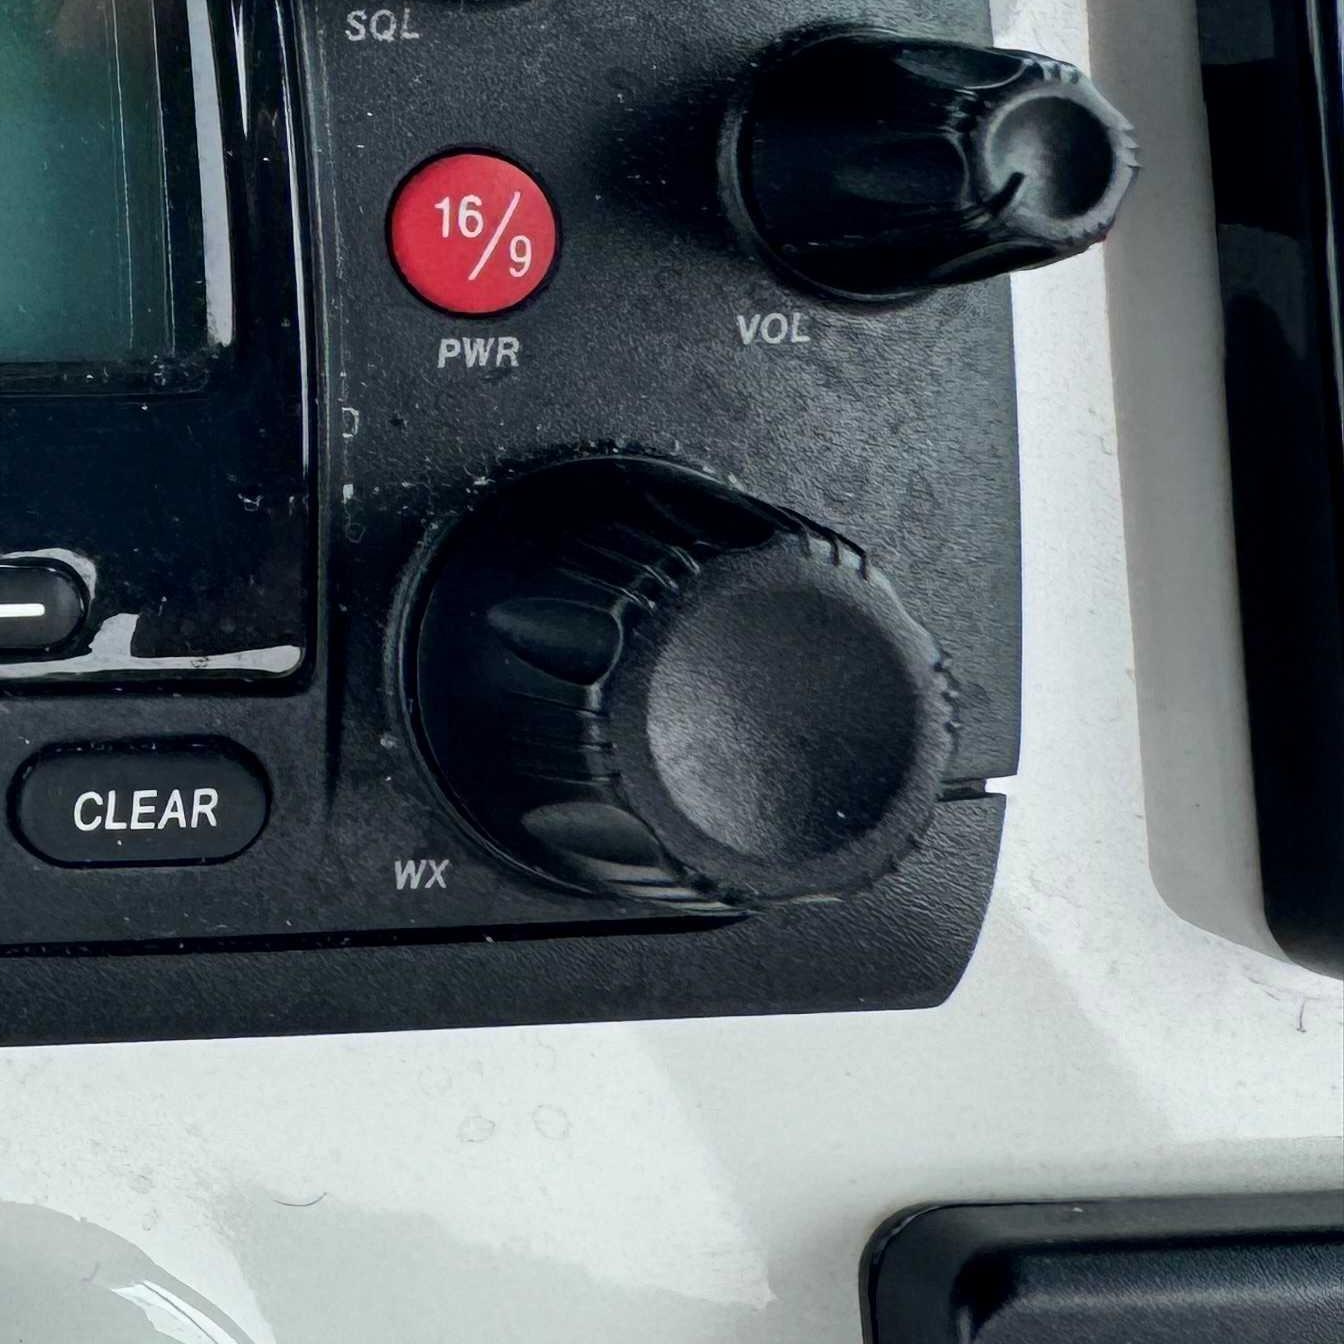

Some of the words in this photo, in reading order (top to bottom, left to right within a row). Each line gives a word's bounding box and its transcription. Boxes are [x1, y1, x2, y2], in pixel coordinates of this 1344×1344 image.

[345, 8, 420, 42] SQL
[736, 312, 811, 346] VOL
[437, 336, 520, 368] PWR
[73, 787, 220, 832] CLEAR
[393, 859, 449, 890] WX
